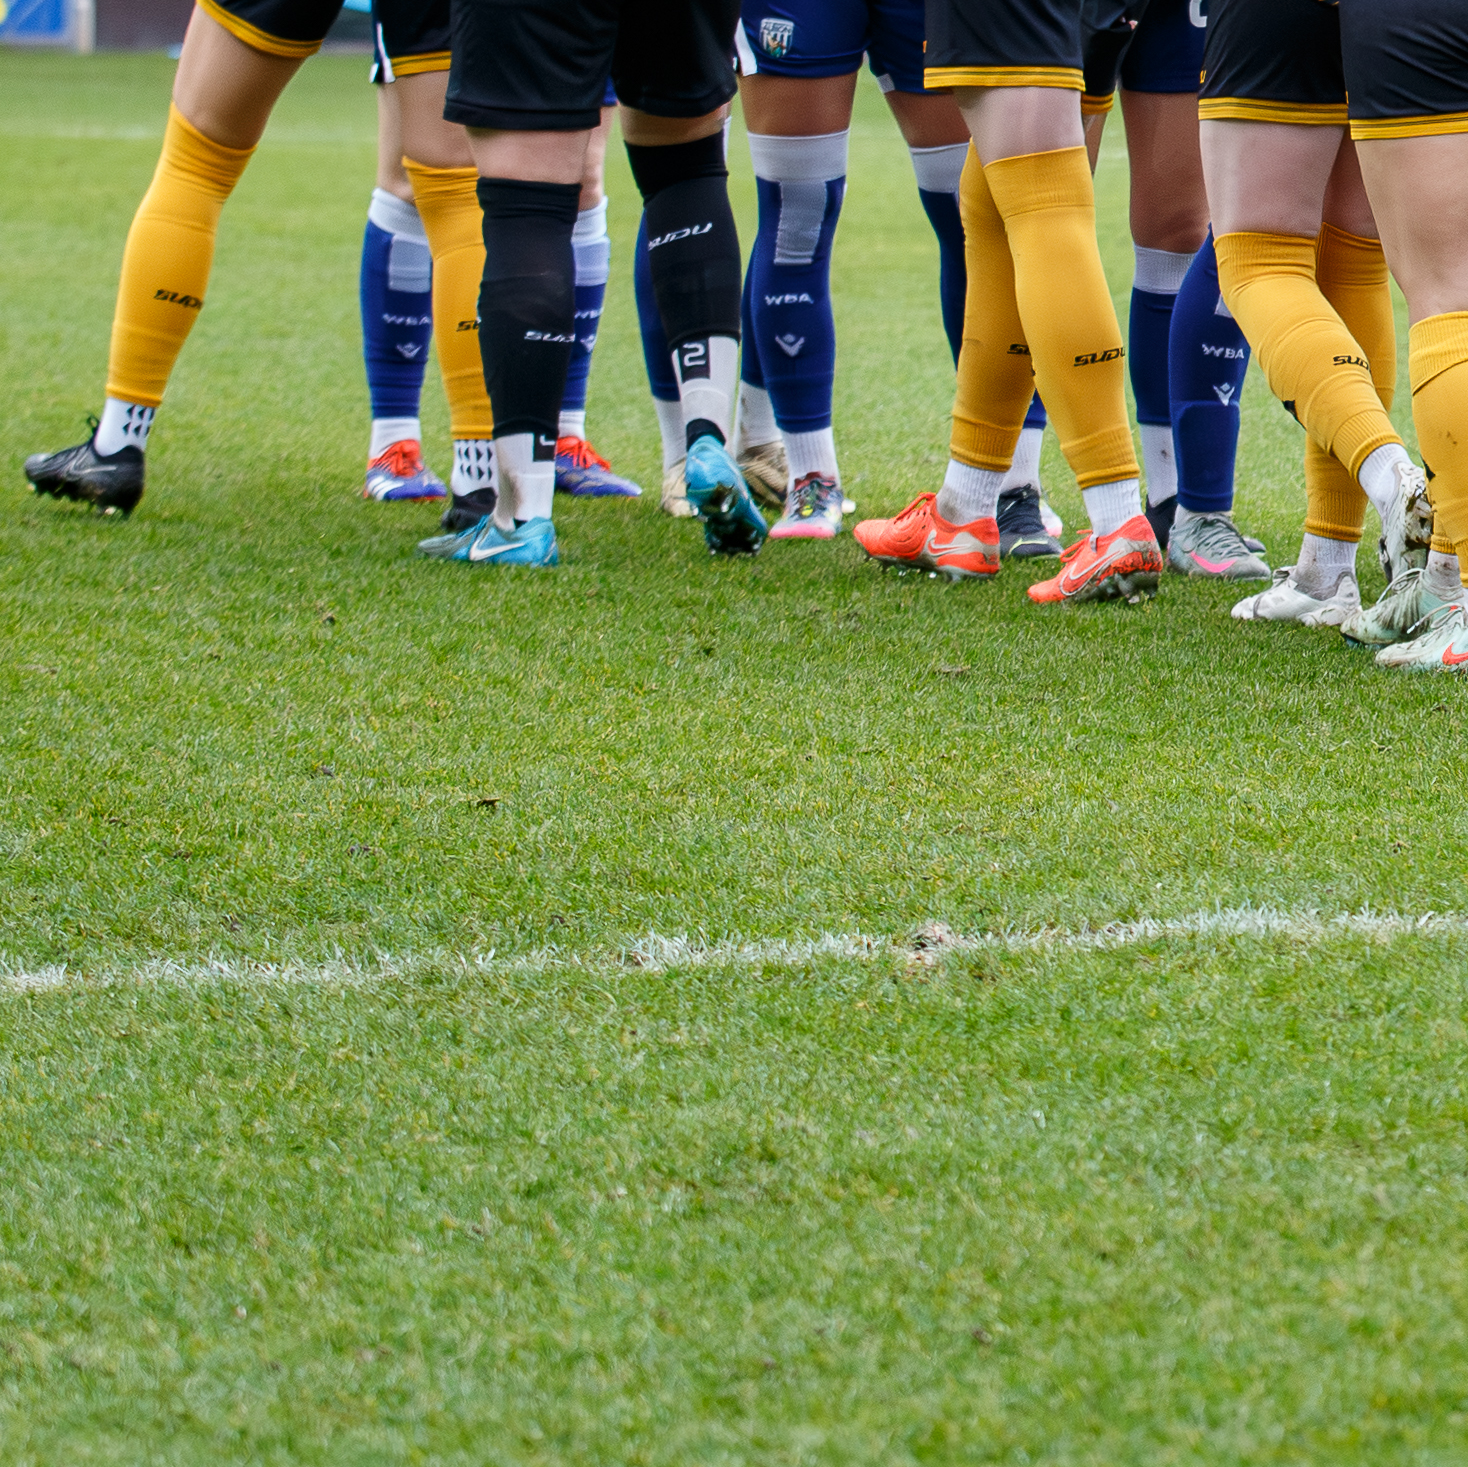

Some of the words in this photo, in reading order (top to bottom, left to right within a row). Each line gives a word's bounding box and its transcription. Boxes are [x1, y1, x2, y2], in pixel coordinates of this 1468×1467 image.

[764, 293, 814, 305] WBA
[382, 313, 431, 325] WBA
[1202, 344, 1245, 360] WBA
